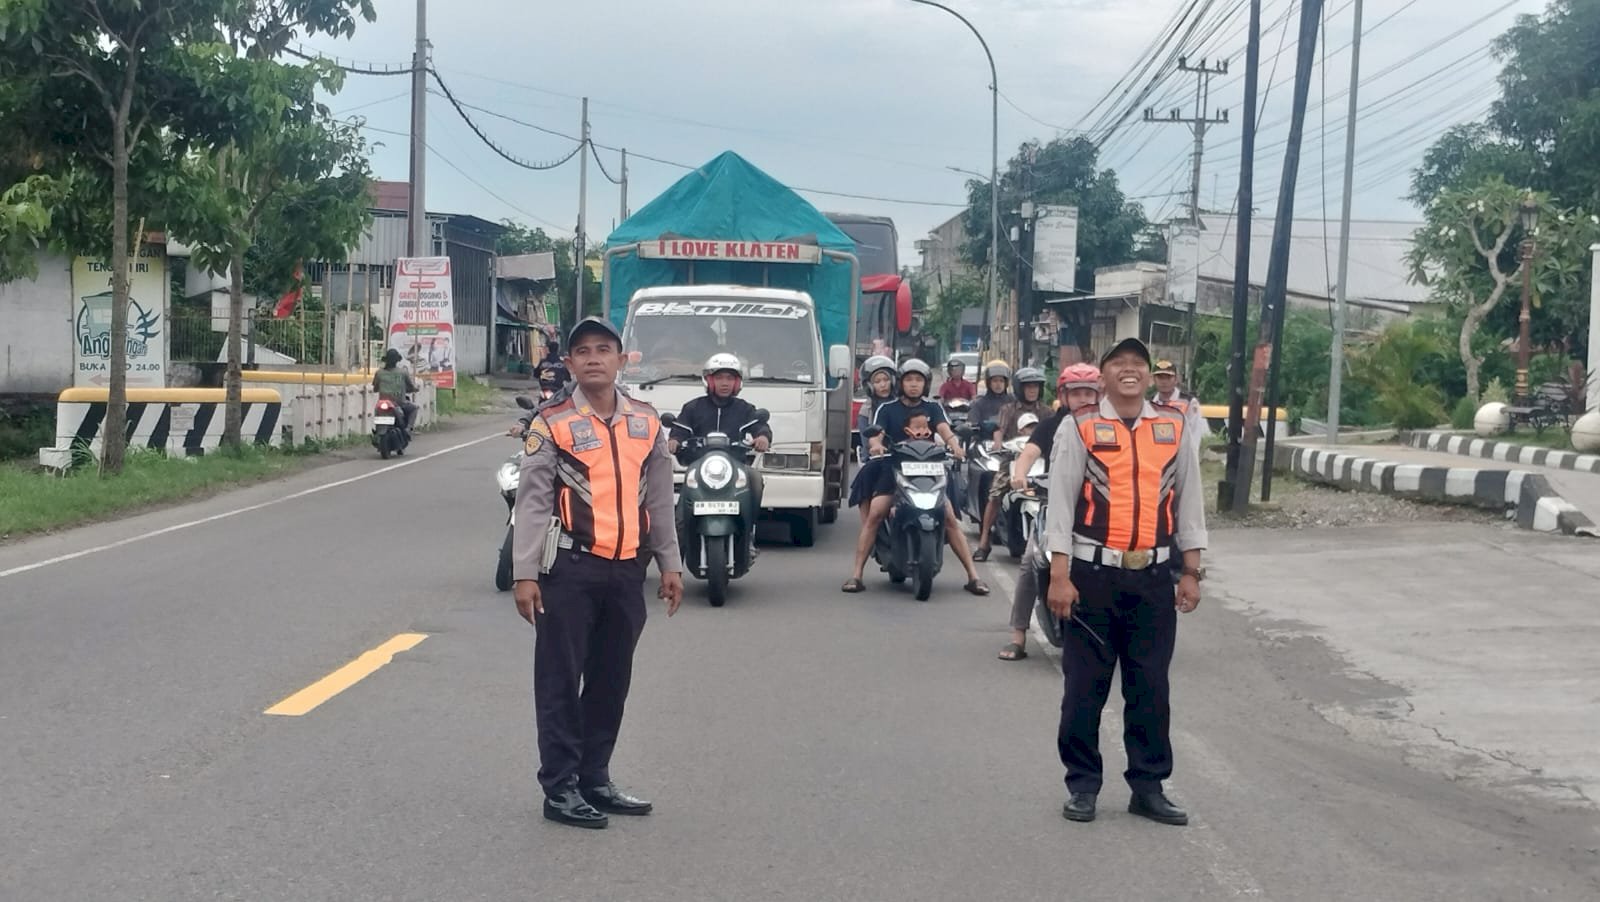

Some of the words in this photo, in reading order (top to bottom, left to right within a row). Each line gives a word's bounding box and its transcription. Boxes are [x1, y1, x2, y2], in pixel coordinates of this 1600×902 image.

[659, 239, 665, 256] I
[672, 241, 718, 257] LOVE
[725, 242, 800, 260] KLATEN
[419, 291, 441, 299] OGGING
[398, 300, 418, 308] GENERA
[421, 300, 439, 308] CHECK
[440, 301, 449, 309] UP
[403, 310, 413, 320] 40
